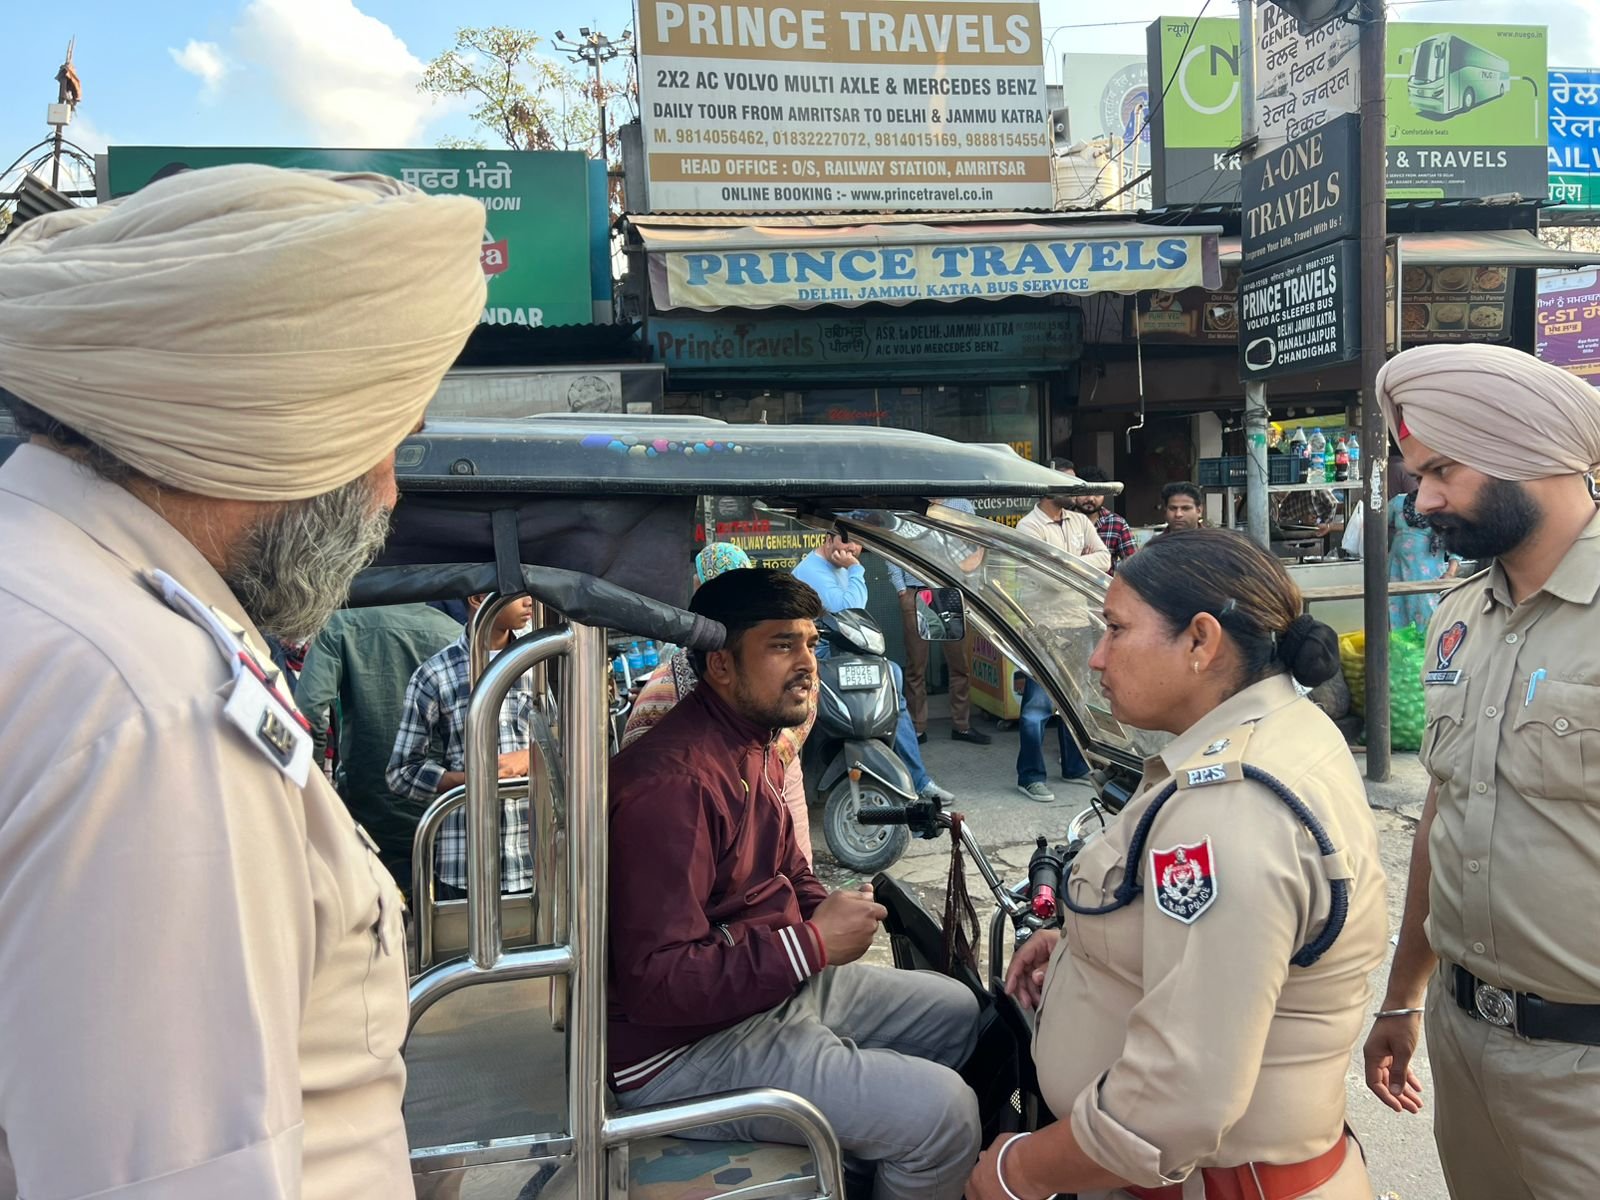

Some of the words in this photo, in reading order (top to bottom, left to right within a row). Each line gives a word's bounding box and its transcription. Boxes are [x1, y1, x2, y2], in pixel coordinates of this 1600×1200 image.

[655, 1, 827, 50] PRINCE
[840, 11, 1031, 55] TRAVELS
[1263, 4, 1290, 34] RA
[1261, 19, 1298, 50] GENER
[657, 69, 690, 89] 2X2
[696, 71, 719, 90] AC
[724, 72, 779, 92] VOLVO
[785, 74, 835, 94] MULTI
[840, 76, 880, 95] AXLE
[886, 77, 897, 95] &
[903, 78, 991, 96] MERCEDES
[996, 78, 1037, 96] BENZ
[1549, 72, 1600, 105] ਰੇਲ
[653, 102, 694, 119] DAILY
[698, 103, 737, 120] TOUR
[742, 105, 783, 121] FROM
[788, 106, 860, 122] AMRITSAR
[864, 108, 882, 123] TO
[887, 108, 926, 123] DELHI
[931, 109, 941, 123] &
[946, 109, 996, 123] JAMMU
[1001, 109, 1044, 123] KATRA
[1549, 106, 1600, 138] रेल
[654, 128, 672, 143] M.
[676, 129, 769, 147] 9814056462,
[773, 131, 871, 148] 01832227072,
[875, 132, 961, 148] 9814015169,
[966, 133, 1046, 147] 9888154554
[680, 158, 721, 175] HEAD
[726, 159, 778, 175] OFFICE
[792, 160, 820, 178] O/S,
[824, 160, 885, 176] RAILWAY
[889, 161, 951, 178] STATION,
[955, 161, 1026, 176] AMRITSAR
[1260, 133, 1323, 192] A-ONE
[1396, 151, 1410, 168] &
[1417, 151, 1508, 168] TRAVELS
[1547, 147, 1600, 168] AIL
[721, 186, 769, 201] ONLINE
[774, 187, 832, 201] BOOKING
[851, 187, 993, 203] www.princetravel.co.in
[1548, 176, 1583, 202] वेश
[476, 196, 521, 211] MONI
[1247, 171, 1340, 239] TRAVELS
[1266, 240, 1279, 254] Your
[1294, 226, 1313, 243] Travel
[1313, 220, 1328, 236] With
[1329, 217, 1338, 230] Us
[683, 247, 917, 286] PRINCE
[931, 238, 1189, 278] TRAVELS
[926, 282, 982, 298] KATRA
[987, 280, 1019, 294] BUS
[1022, 277, 1090, 293] SERVICE
[1243, 283, 1282, 320] PRINCE
[1284, 264, 1337, 307] TRAVELS
[481, 307, 543, 327] NDAR
[1246, 315, 1269, 331] VOLVO
[1270, 313, 1280, 325] AC
[1281, 303, 1315, 322] SLEEPER
[1316, 296, 1334, 311] BUS
[1277, 322, 1294, 338] DELHI
[1295, 318, 1315, 333] JAMMU
[1316, 309, 1337, 327] KATRA
[657, 330, 735, 361] Prince
[734, 323, 815, 358] Travels
[983, 321, 1014, 337] KATRA
[1278, 334, 1306, 352] MANALI
[1306, 326, 1337, 345] JAIPUR
[893, 343, 922, 355] VOLVO
[924, 341, 972, 354] MERCEDES
[1278, 341, 1337, 365] CHANDIGHAR
[730, 534, 765, 551] RAILWAY
[766, 533, 802, 550] GENERAL
[802, 533, 826, 548] TICKE
[972, 657, 1000, 689] KATRA
[1187, 887, 1211, 913] POLICE
